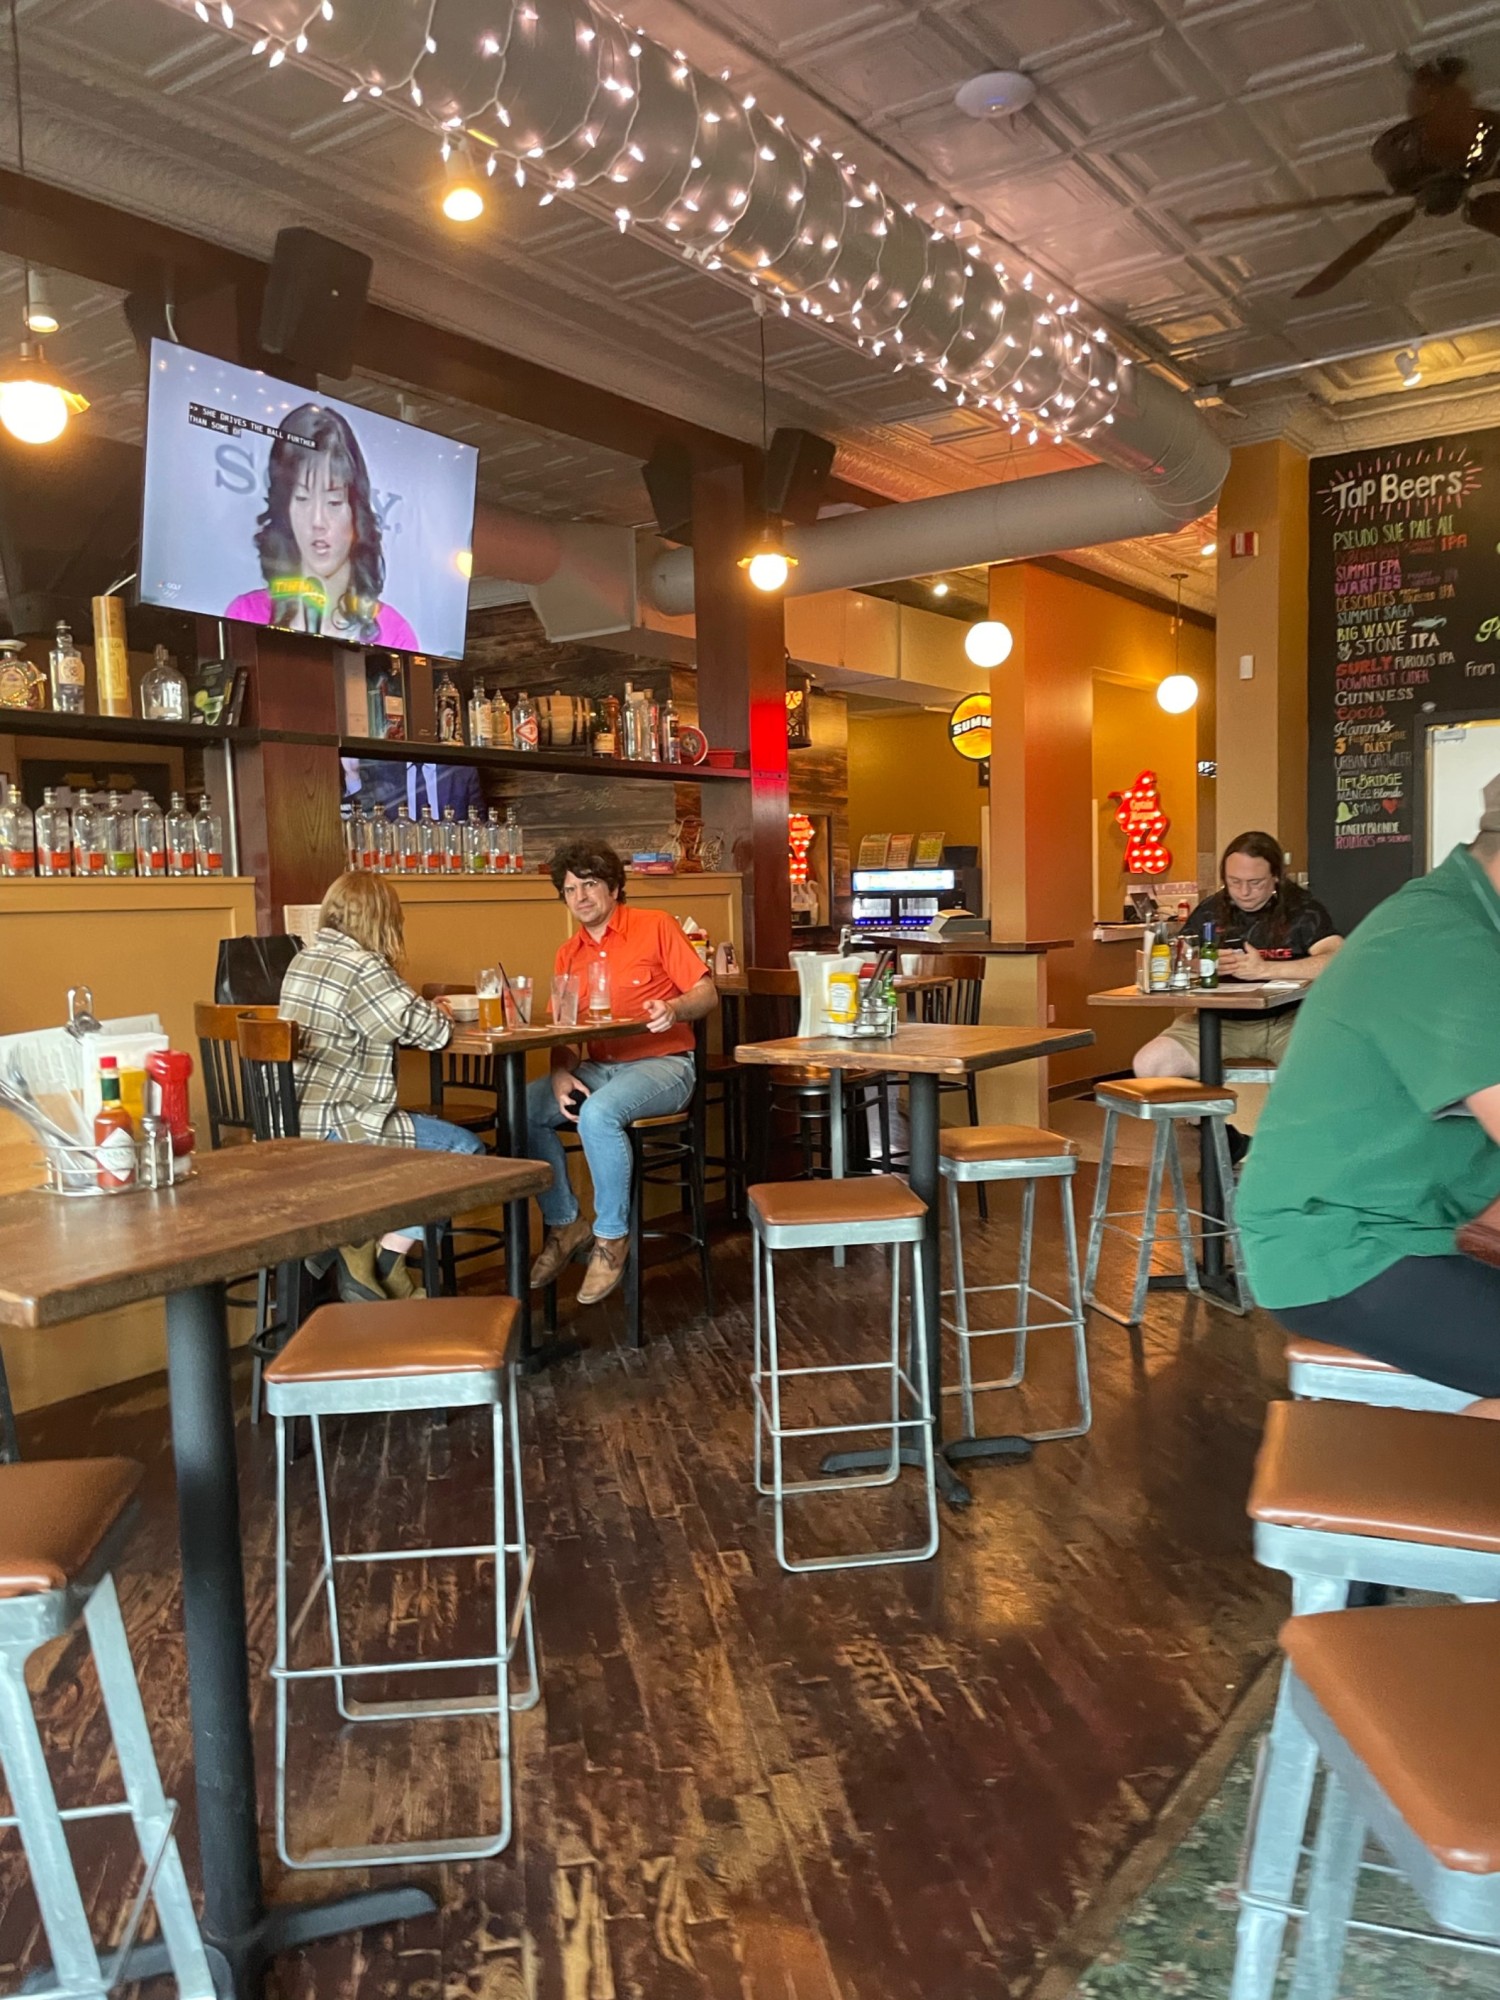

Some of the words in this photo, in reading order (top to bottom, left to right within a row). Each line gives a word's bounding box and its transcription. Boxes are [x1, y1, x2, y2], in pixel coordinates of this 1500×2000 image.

[189, 415, 208, 427] THAN
[211, 421, 229, 433] SOME
[202, 407, 217, 420] SHE
[219, 412, 247, 427] DRIVES
[250, 422, 264, 433] THE
[266, 428, 284, 440] BALL
[287, 432, 317, 448] FURTHER
[1380, 470, 1464, 504] Beers
[1333, 527, 1379, 551] PSEUDO
[1382, 522, 1405, 544] SUE
[1409, 518, 1433, 540] PALE
[1436, 514, 1455, 536] ALE
[1441, 534, 1468, 552] IPA
[1336, 561, 1377, 581] SUMMIT
[1379, 558, 1401, 577] EPA
[1337, 607, 1381, 626] SUMMIT
[1383, 603, 1415, 621] SAGA
[1336, 626, 1359, 643] BIG
[1362, 619, 1408, 639] WAVE
[1355, 634, 1406, 656] STONE
[1410, 632, 1440, 650] IPA
[1336, 655, 1393, 677] SURLY
[1438, 651, 1456, 666] IPA
[1465, 661, 1496, 677] From
[1364, 741, 1393, 754] DUST
[1358, 772, 1403, 790] BRIDGE
